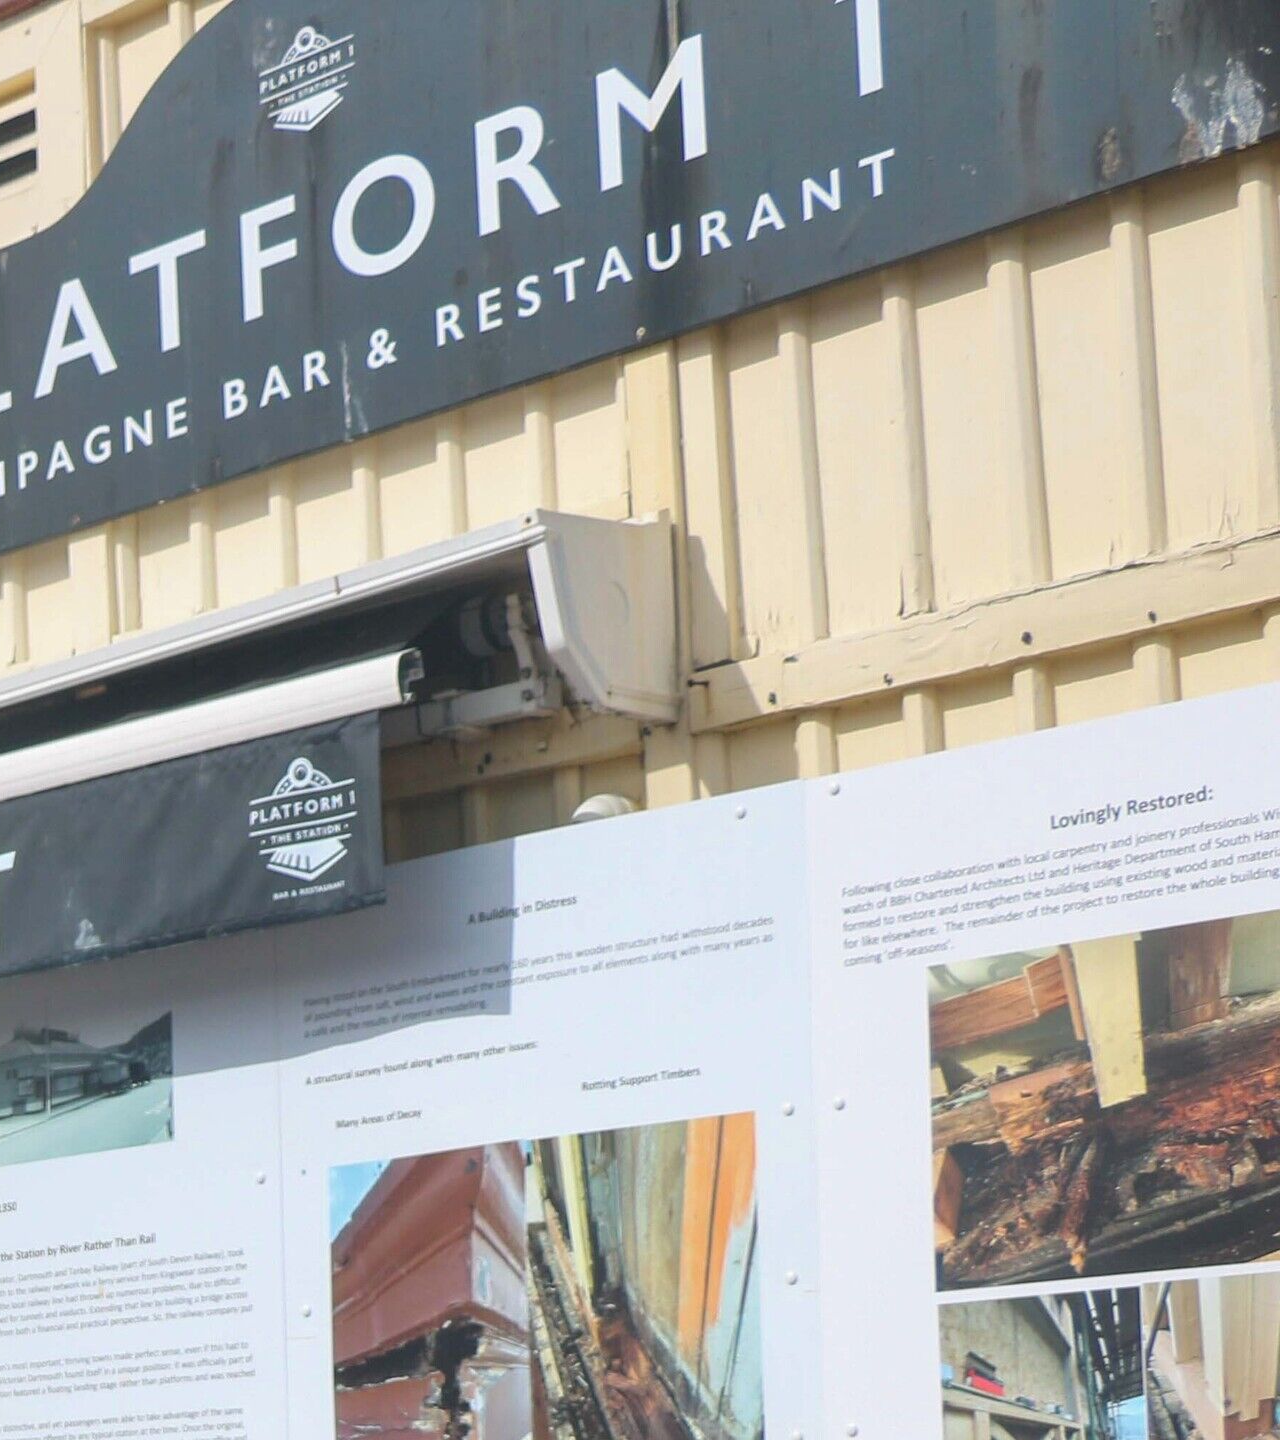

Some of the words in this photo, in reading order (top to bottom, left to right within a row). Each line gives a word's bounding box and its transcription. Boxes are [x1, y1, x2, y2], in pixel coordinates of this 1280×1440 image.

[834, 0, 883, 97] 1
[260, 50, 340, 94] PLATFORM
[348, 44, 354, 57] 1
[298, 77, 338, 97] STATION
[222, 350, 331, 419] BAR
[365, 329, 397, 369] &
[435, 148, 895, 347] RESTAURANT
[249, 793, 343, 826] PLATFORM
[349, 790, 356, 805] 1
[1050, 804, 1120, 829] Lovingly
[1126, 786, 1214, 815] Restored:
[271, 832, 292, 845] THE
[295, 824, 341, 840] STATION
[841, 881, 892, 897] Following
[893, 876, 921, 888] close
[922, 862, 994, 883] collaboration
[996, 855, 1021, 870] with
[1023, 850, 1050, 865] local
[1052, 842, 1107, 860] carpentry
[1110, 835, 1132, 850] and
[1134, 830, 1176, 848] joinery
[1178, 813, 1260, 840] professionals
[1262, 808, 1280, 822] Wi
[272, 891, 289, 901] BAR
[299, 880, 345, 895] RESTAURANT
[842, 899, 874, 914] watch
[876, 897, 888, 909] of
[913, 883, 968, 902] Chartered
[970, 874, 1026, 892] Architects
[1027, 869, 1046, 883] Ltd
[1048, 865, 1070, 879] and
[1072, 859, 1122, 875] Heritage
[1124, 843, 1196, 866] Department
[1198, 840, 1212, 853] of
[1214, 833, 1251, 850] South
[842, 916, 881, 932] formed
[882, 914, 895, 925] to
[896, 909, 936, 923] restore
[938, 902, 958, 916] and
[960, 894, 1020, 912] strengthen
[1022, 889, 1042, 901] the
[1044, 882, 1090, 898] building
[1092, 876, 1123, 889] using
[1125, 868, 1171, 884] existing
[1173, 859, 1208, 875] wood
[1210, 854, 1234, 869] and
[468, 914, 476, 925] A
[477, 907, 520, 923] Building
[521, 903, 532, 915] in
[534, 897, 577, 912] Distress
[844, 939, 858, 949] for
[860, 935, 879, 947] like
[945, 920, 964, 932] The
[966, 910, 1024, 928] remainder
[1026, 906, 1038, 918] of
[1040, 903, 1060, 916] the
[1062, 894, 1103, 915] project
[1105, 893, 1118, 905] to
[1120, 887, 1164, 902] restore
[1166, 881, 1187, 894] the
[1189, 874, 1227, 890] whole
[530, 956, 554, 970] years
[555, 951, 573, 963] this
[574, 946, 613, 959] wooden
[614, 938, 658, 952] structure
[660, 932, 679, 944] had
[680, 923, 730, 941] withstood
[732, 918, 773, 932] decades
[844, 952, 882, 966] coming
[305, 1076, 312, 1085] A
[312, 1068, 353, 1084] structural
[354, 1066, 381, 1077] survey
[382, 1060, 408, 1073] found
[409, 1058, 433, 1068] along
[434, 1052, 454, 1064] with
[456, 1050, 480, 1061] many
[482, 1045, 506, 1056] other
[582, 1078, 617, 1091] Rotting
[618, 1072, 658, 1088] Support
[660, 1068, 701, 1081] Timbers
[336, 1118, 359, 1128] Many
[360, 1115, 384, 1125] Areas
[385, 1110, 396, 1121] of
[395, 1109, 423, 1120] Decay
[0, 1251, 13, 1262] the
[15, 1248, 45, 1260] Station
[46, 1246, 58, 1258] by
[58, 1244, 81, 1254] River
[83, 1239, 112, 1251] Rather
[114, 1236, 137, 1247] Than
[138, 1232, 157, 1244] Rail
